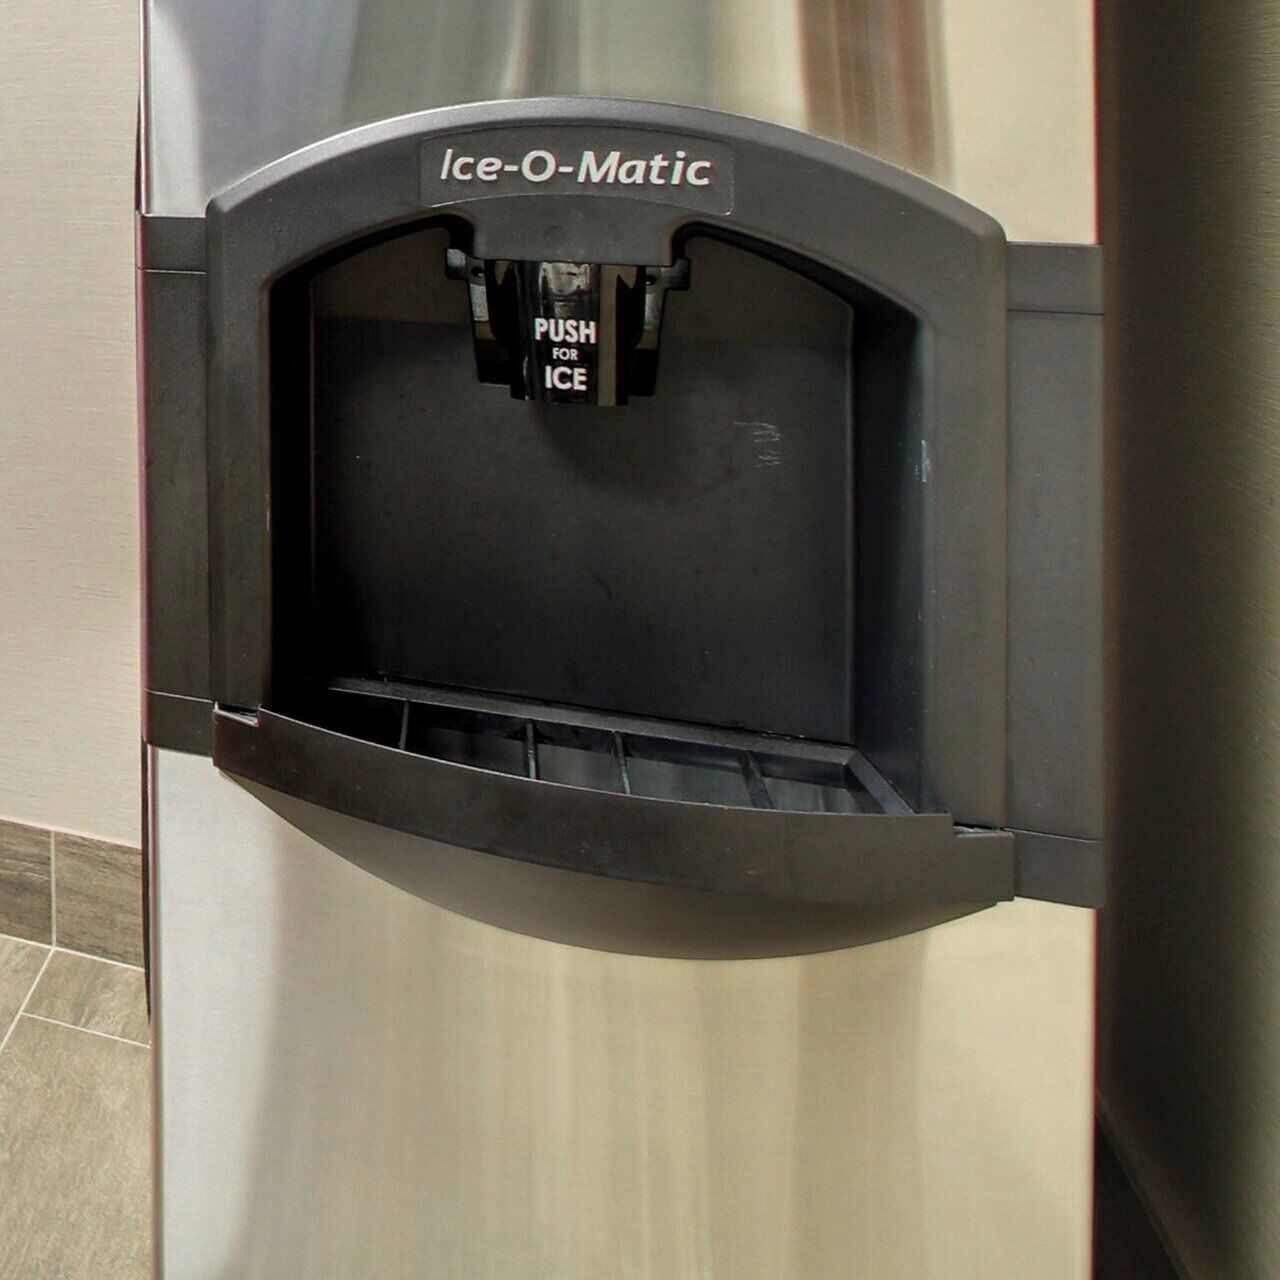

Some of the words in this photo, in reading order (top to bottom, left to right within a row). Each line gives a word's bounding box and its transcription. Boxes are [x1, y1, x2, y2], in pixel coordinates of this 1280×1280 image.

[441, 148, 712, 186] Ice-O-Matic
[534, 317, 597, 344] PUSH
[552, 347, 579, 362] FOR
[544, 365, 588, 391] ICE
